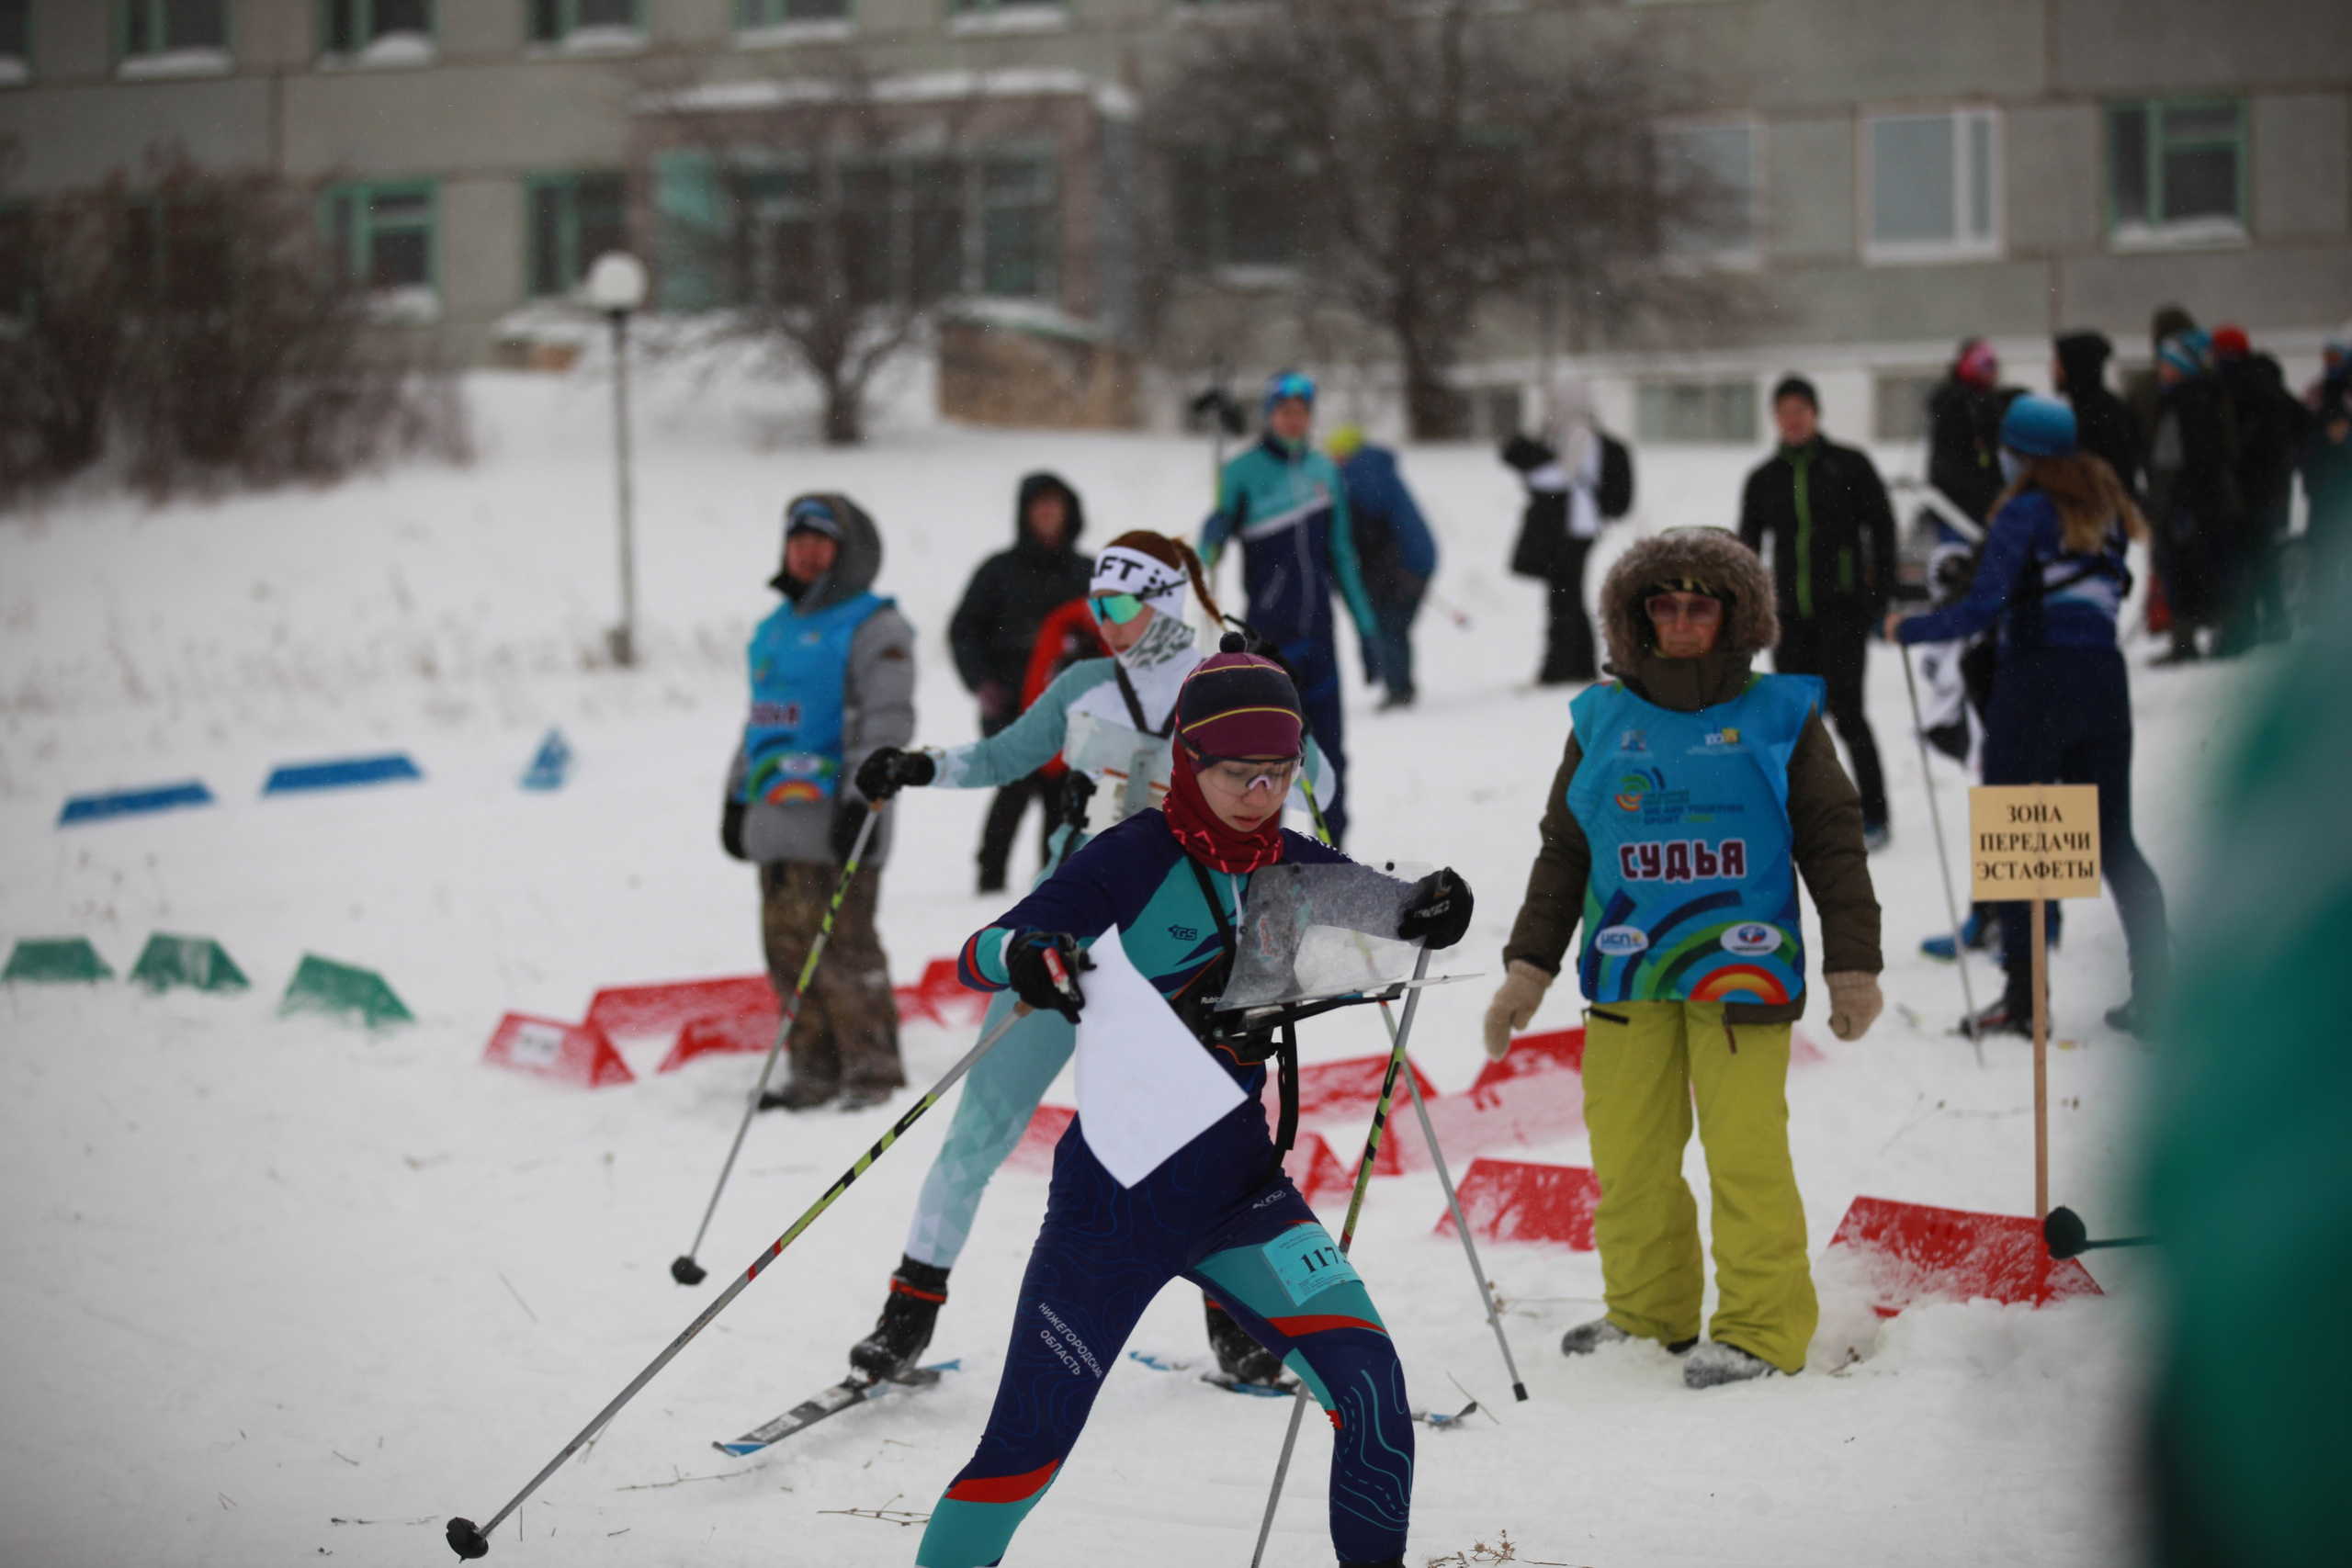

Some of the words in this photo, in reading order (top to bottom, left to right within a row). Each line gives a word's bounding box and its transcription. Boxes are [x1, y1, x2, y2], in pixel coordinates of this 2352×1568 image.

[1091, 556, 1144, 581] FT
[2007, 804, 2063, 823] ЗОНА
[1980, 832, 2091, 853] ПЕРЕДАЧИ
[1620, 840, 1746, 883] СУДЬЯ
[1976, 860, 2095, 881] ЭСТАФЕТЫ
[1201, 996, 1222, 1004] Rubic
[1038, 1303, 1102, 1379] НИЖЕГОРОДСКАЯ
[1040, 1330, 1080, 1376] ОБЛАСТЬ
